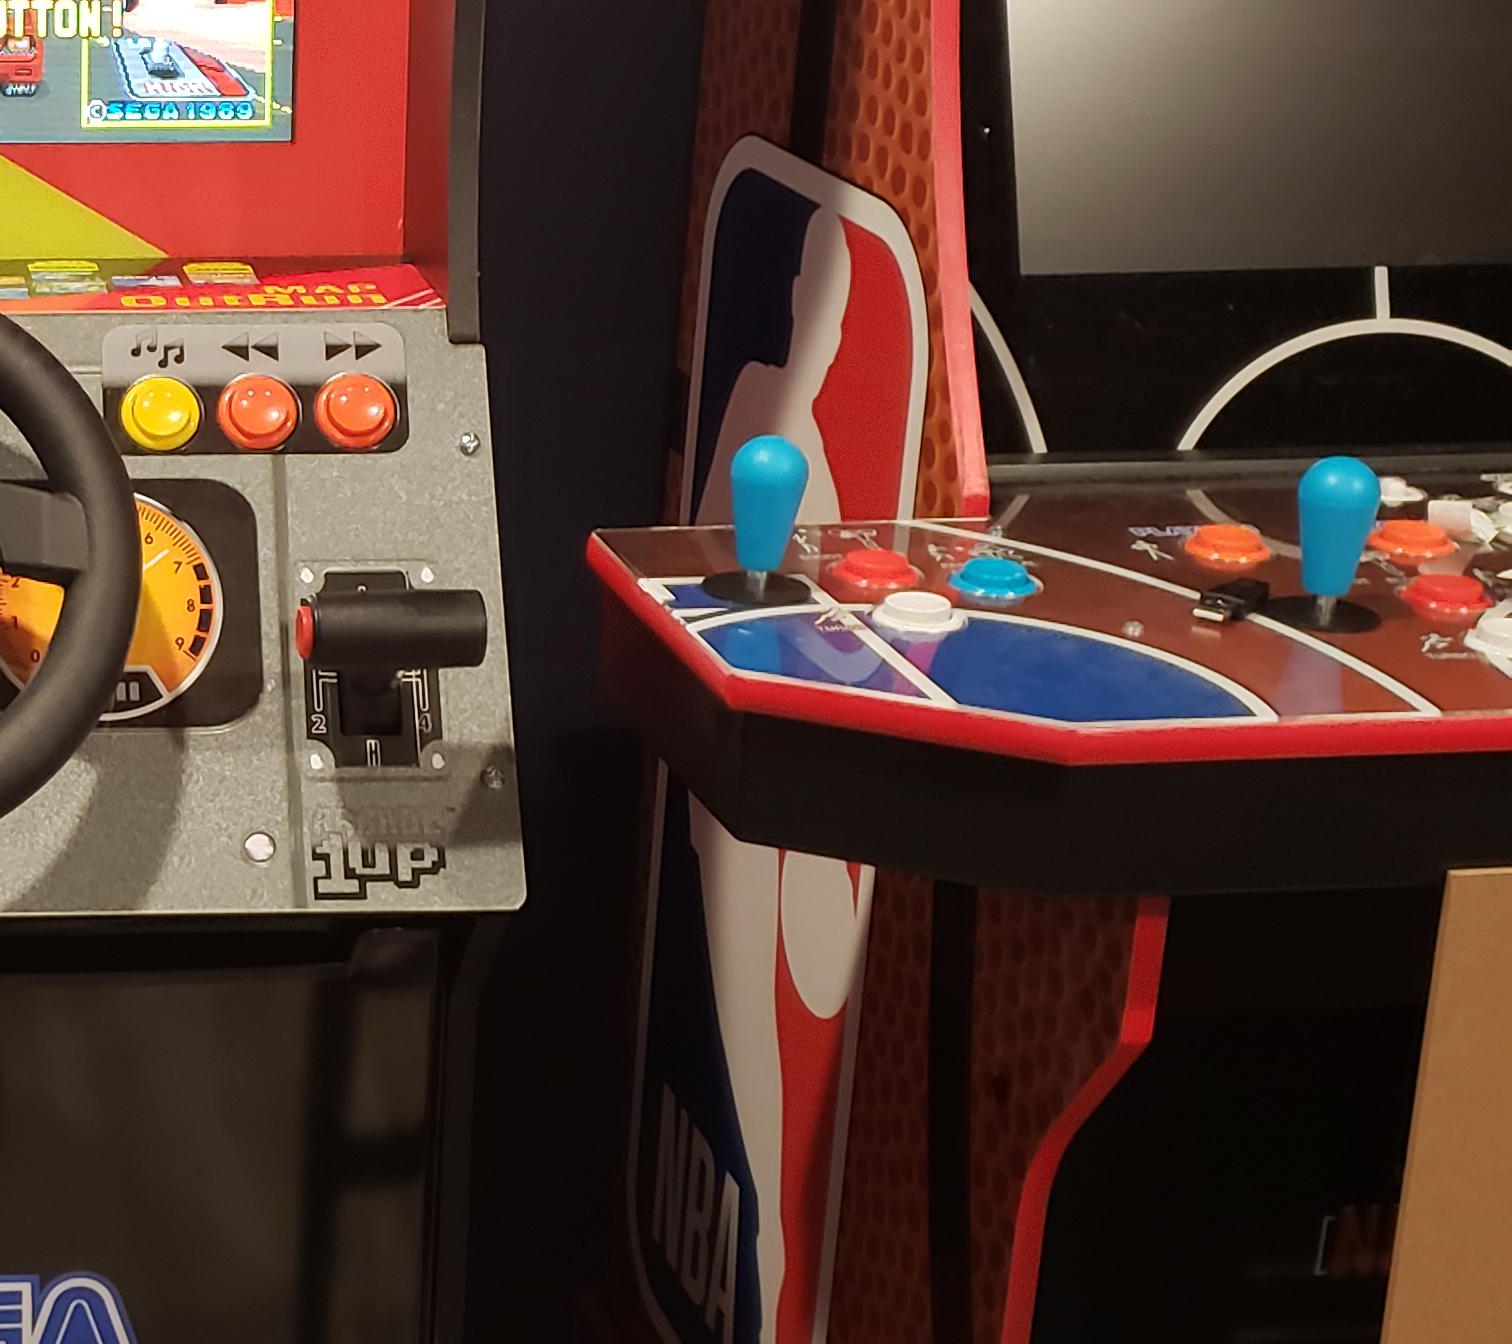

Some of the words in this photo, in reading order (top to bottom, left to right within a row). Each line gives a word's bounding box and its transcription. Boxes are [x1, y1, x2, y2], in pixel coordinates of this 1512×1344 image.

[187, 102, 254, 120] 1989
[144, 531, 154, 545] 6
[173, 560, 183, 574] 7
[186, 598, 196, 613] 8
[174, 636, 185, 651] 9
[29, 649, 41, 663] 0
[311, 712, 328, 735] 2
[311, 834, 447, 900] 1UP
